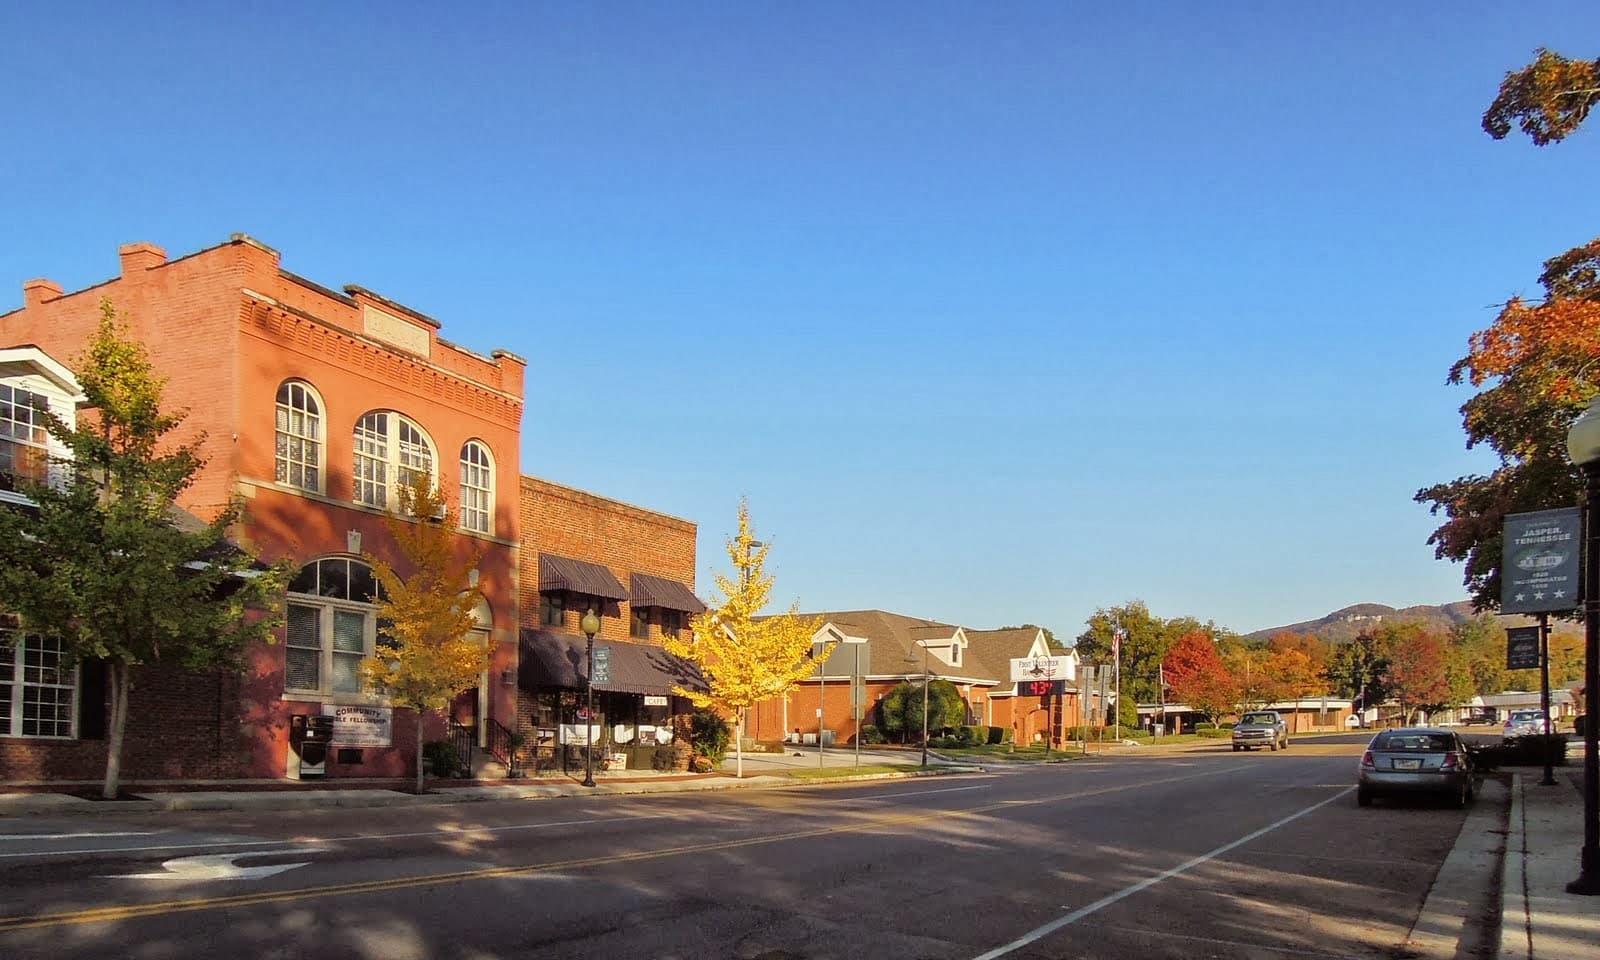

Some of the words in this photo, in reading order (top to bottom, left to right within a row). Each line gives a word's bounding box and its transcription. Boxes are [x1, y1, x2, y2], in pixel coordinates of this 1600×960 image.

[1523, 527, 1562, 537] JASPER,
[1514, 533, 1571, 545] TENNESSEE
[336, 708, 381, 718] COMMUNITY
